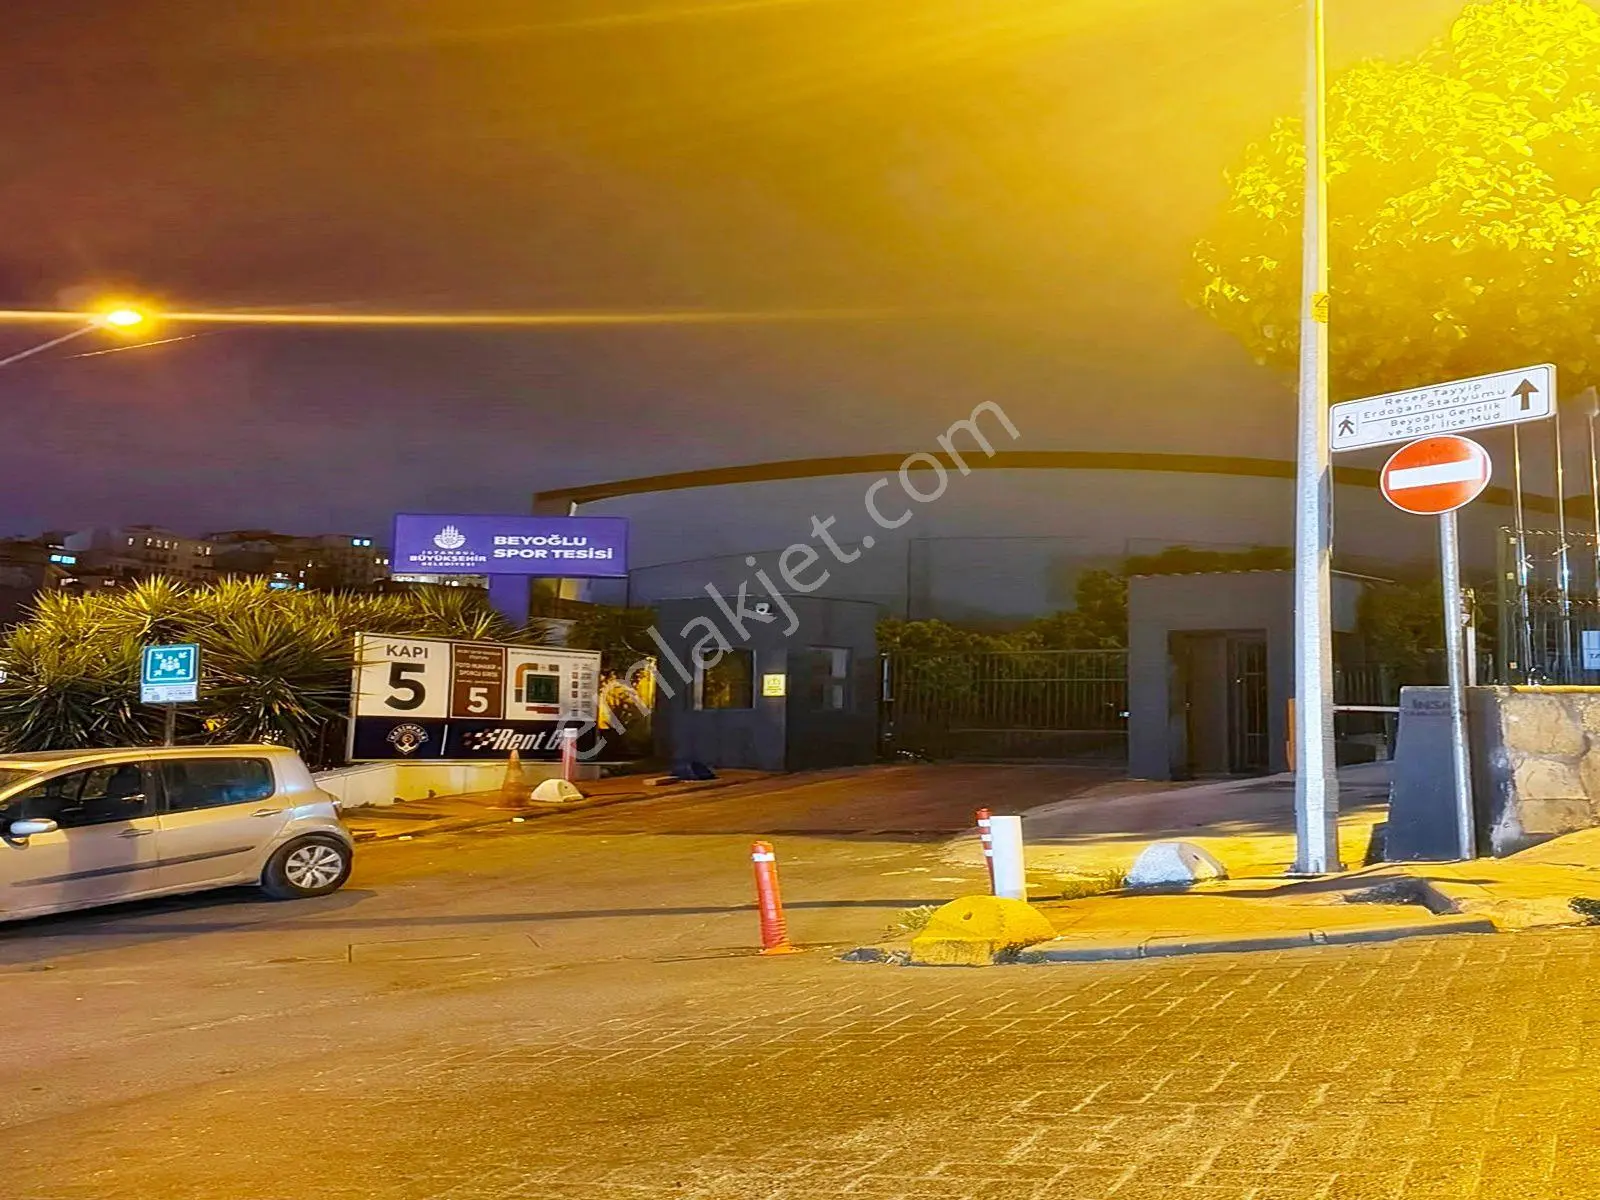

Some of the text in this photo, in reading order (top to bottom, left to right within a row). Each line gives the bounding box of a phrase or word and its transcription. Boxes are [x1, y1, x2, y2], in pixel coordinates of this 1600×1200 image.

[1385, 384, 1482, 405] Recep Tayyip
[1406, 423, 1436, 434] Spor
[493, 534, 587, 546] BEYOĞLU
[493, 547, 613, 559] SPOR TESİSİ
[386, 644, 429, 659] KAPI
[383, 662, 426, 711] 5
[467, 687, 489, 713] 5
[494, 729, 546, 750] Rent
